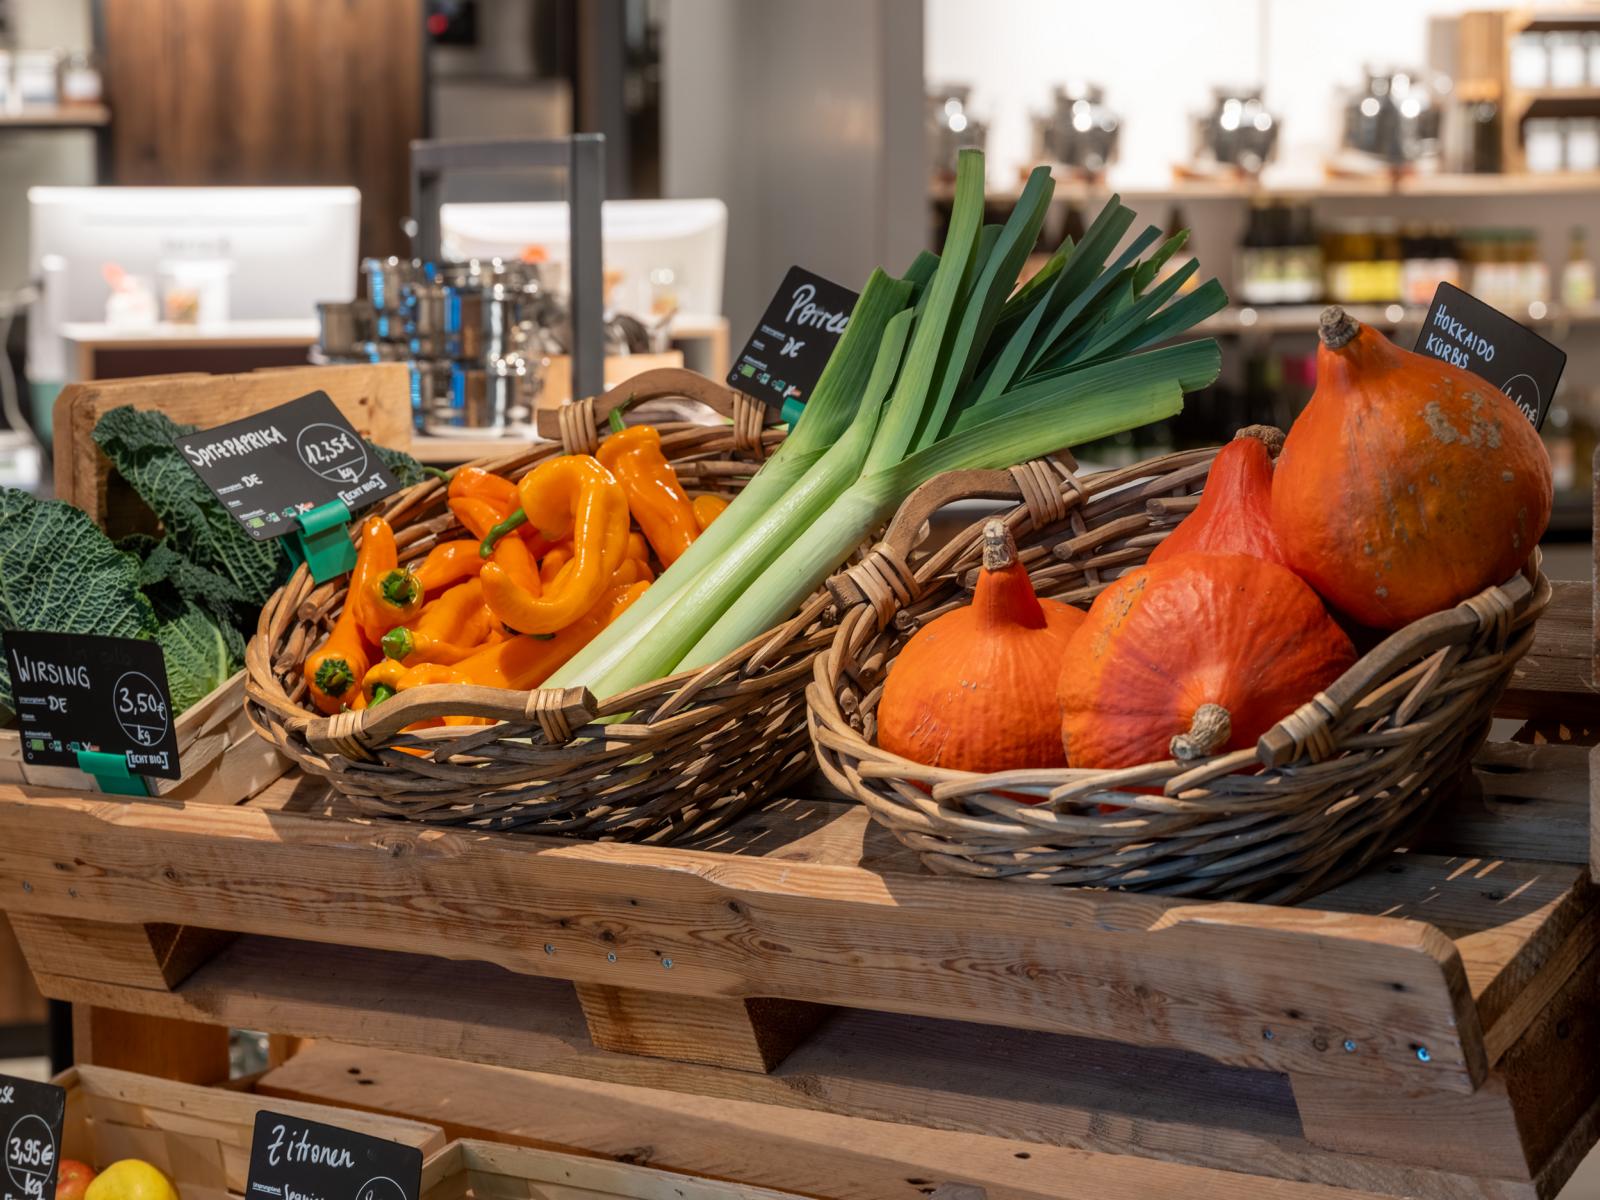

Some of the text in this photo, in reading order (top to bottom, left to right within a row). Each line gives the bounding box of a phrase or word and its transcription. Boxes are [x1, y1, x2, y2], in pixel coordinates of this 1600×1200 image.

[1433, 303, 1495, 362] HOKKAIDO
[1426, 333, 1470, 369] KÜRBIS
[305, 433, 355, 466] 12,35€
[241, 473, 263, 488] DE
[337, 467, 359, 483] kg
[12, 648, 91, 690] WIRSING
[47, 695, 68, 713] DE
[119, 687, 166, 720] 3,50€
[137, 725, 151, 745] kg
[10, 1137, 54, 1166] 3,95€
[267, 1124, 355, 1169] Zitronen
[24, 1173, 45, 1200] kg
